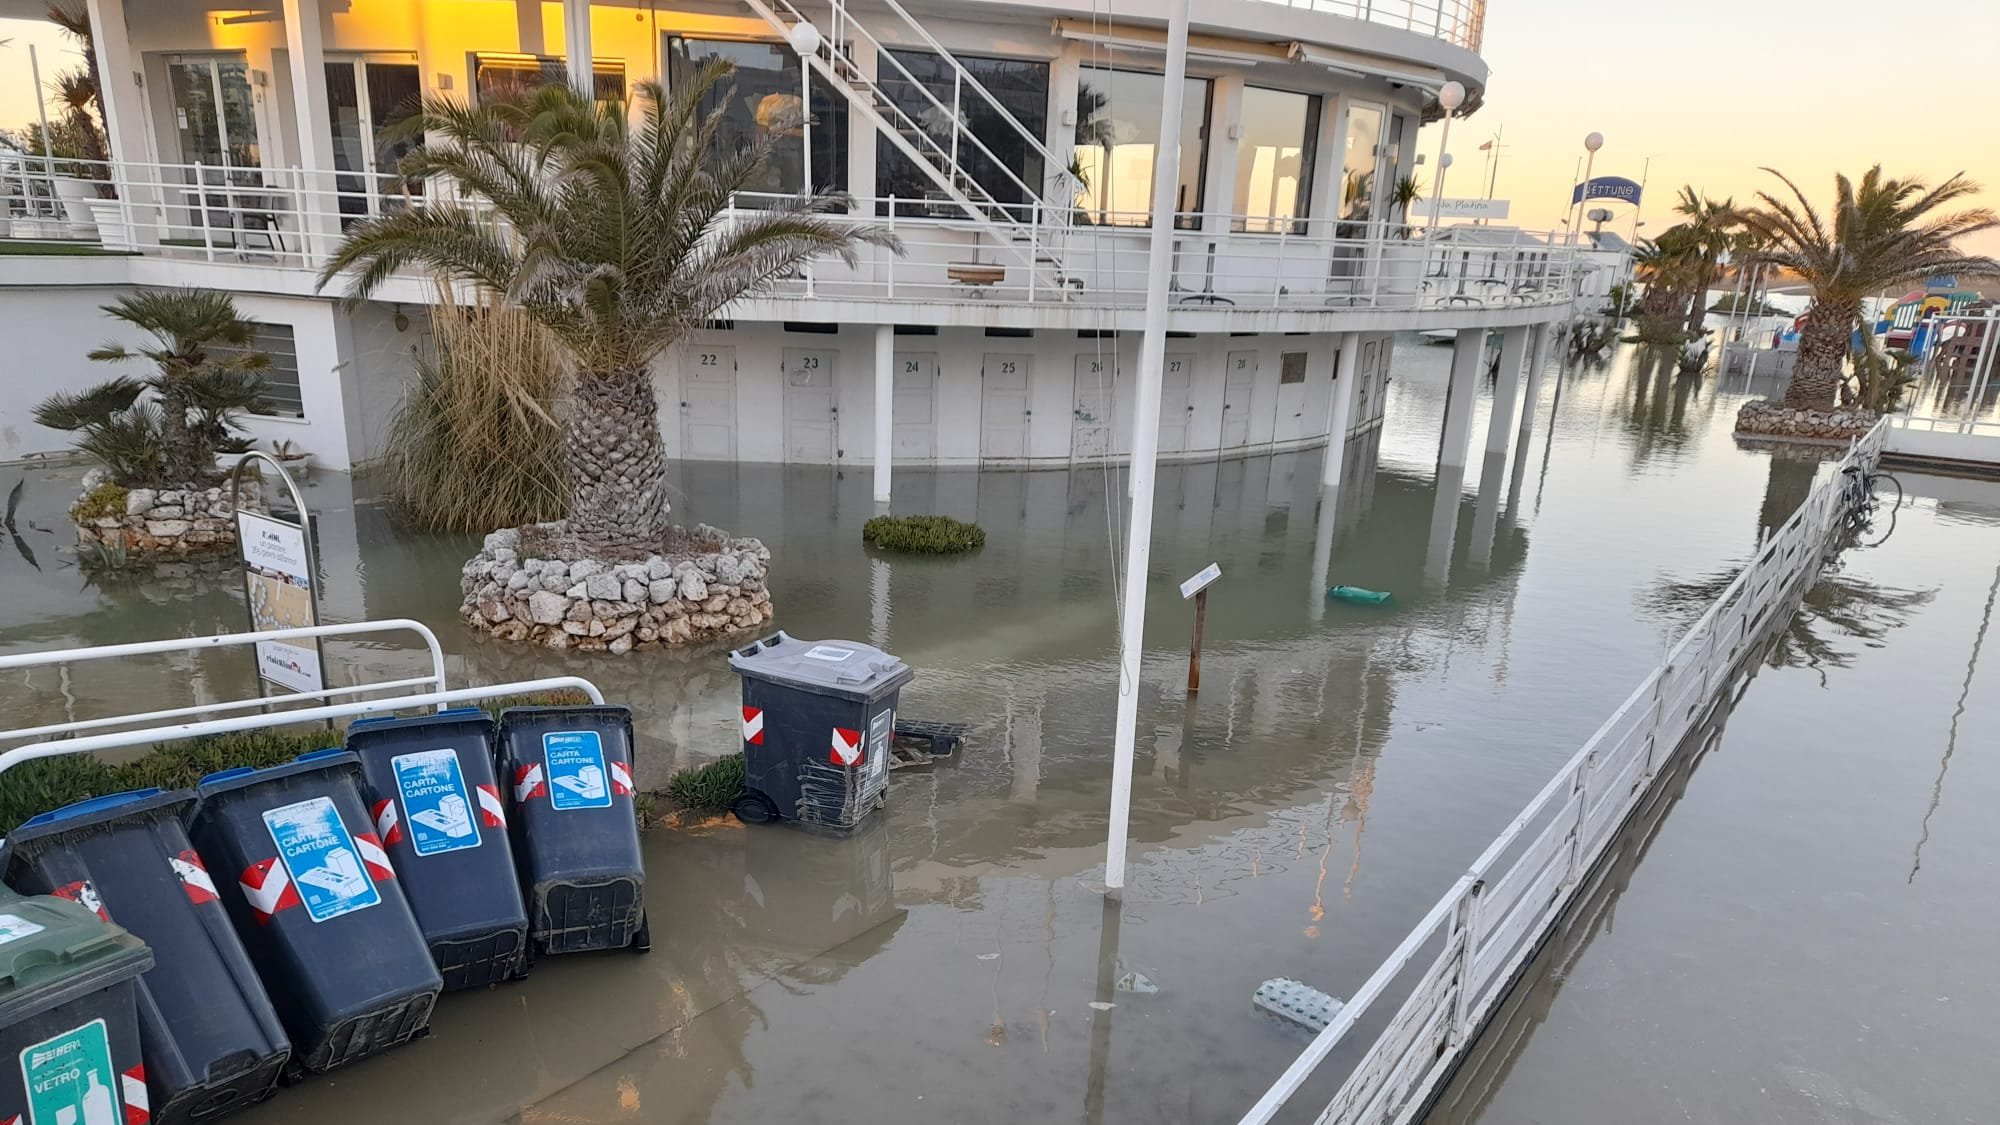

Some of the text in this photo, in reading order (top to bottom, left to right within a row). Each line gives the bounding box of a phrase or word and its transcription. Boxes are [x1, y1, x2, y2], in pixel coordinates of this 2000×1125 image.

[701, 354, 717, 366] 22
[803, 357, 819, 369] 23
[906, 361, 919, 373] 24
[1002, 362, 1016, 374] 25
[1170, 361, 1182, 372] 27
[550, 750, 581, 759] CARTA
[551, 757, 595, 766] CARTONE
[403, 777, 437, 790] CARTA
[405, 783, 455, 798] CARTONE
[286, 835, 341, 857] CARTONE
[33, 1068, 81, 1094] VETRO
